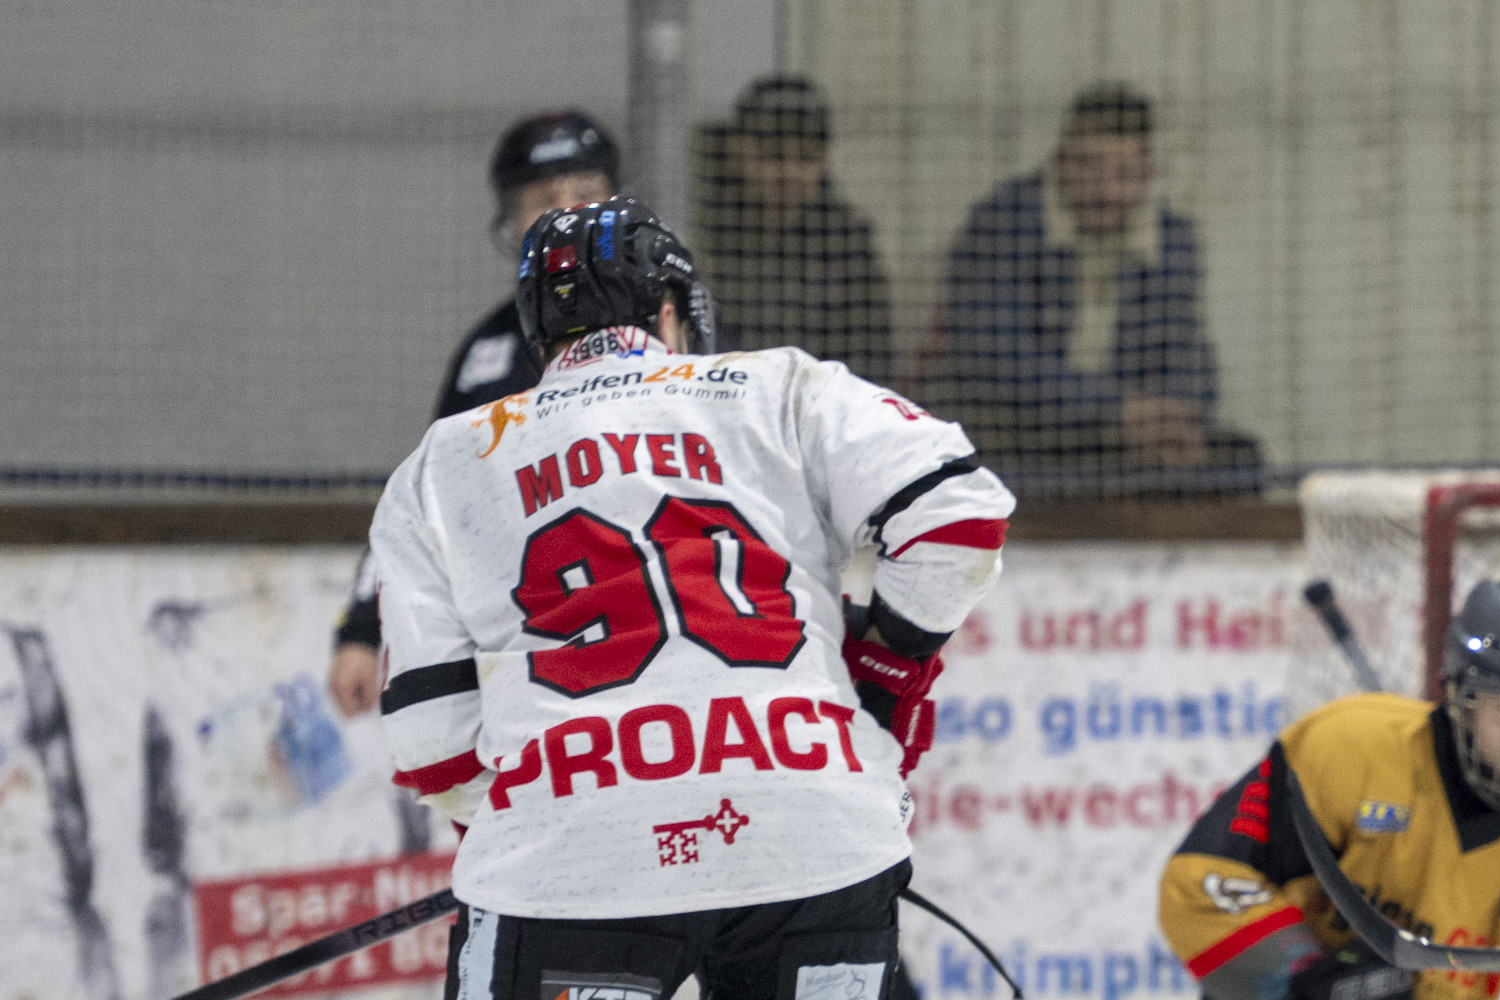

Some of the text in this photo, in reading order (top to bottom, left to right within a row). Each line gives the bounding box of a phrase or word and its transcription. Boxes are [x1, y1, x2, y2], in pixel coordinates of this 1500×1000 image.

[571, 333, 620, 366] 1996
[536, 364, 749, 406] Reifen24.de
[537, 401, 569, 420] Wir
[582, 388, 652, 407] geben
[515, 432, 723, 519] MOYER
[511, 493, 808, 699] 90
[1018, 598, 1148, 655] und
[860, 655, 909, 679] CCM
[488, 696, 864, 811] PROACT
